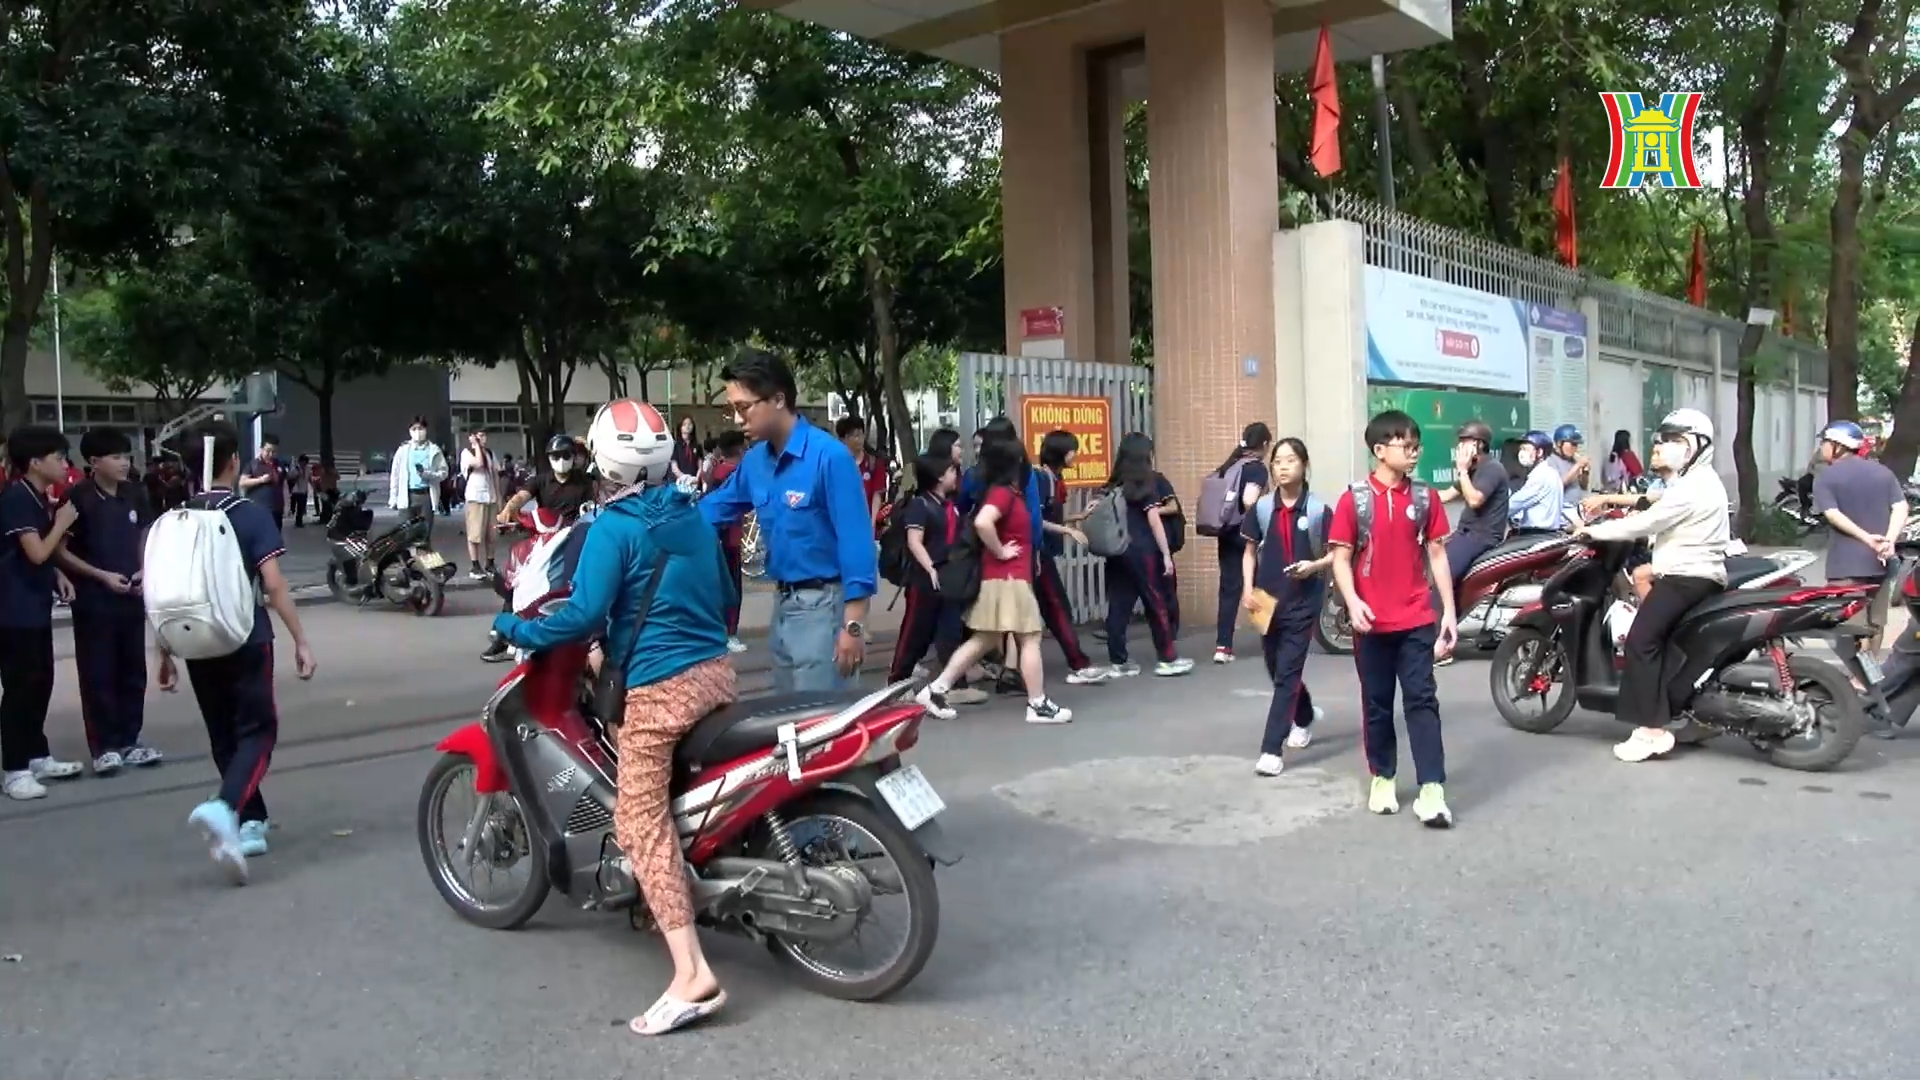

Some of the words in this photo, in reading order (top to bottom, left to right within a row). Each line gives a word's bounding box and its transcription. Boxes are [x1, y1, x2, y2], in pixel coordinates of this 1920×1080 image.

[1030, 403, 1070, 424] KHÔNG
[1073, 403, 1103, 425] DỪNG
[1077, 433, 1103, 455] XE
